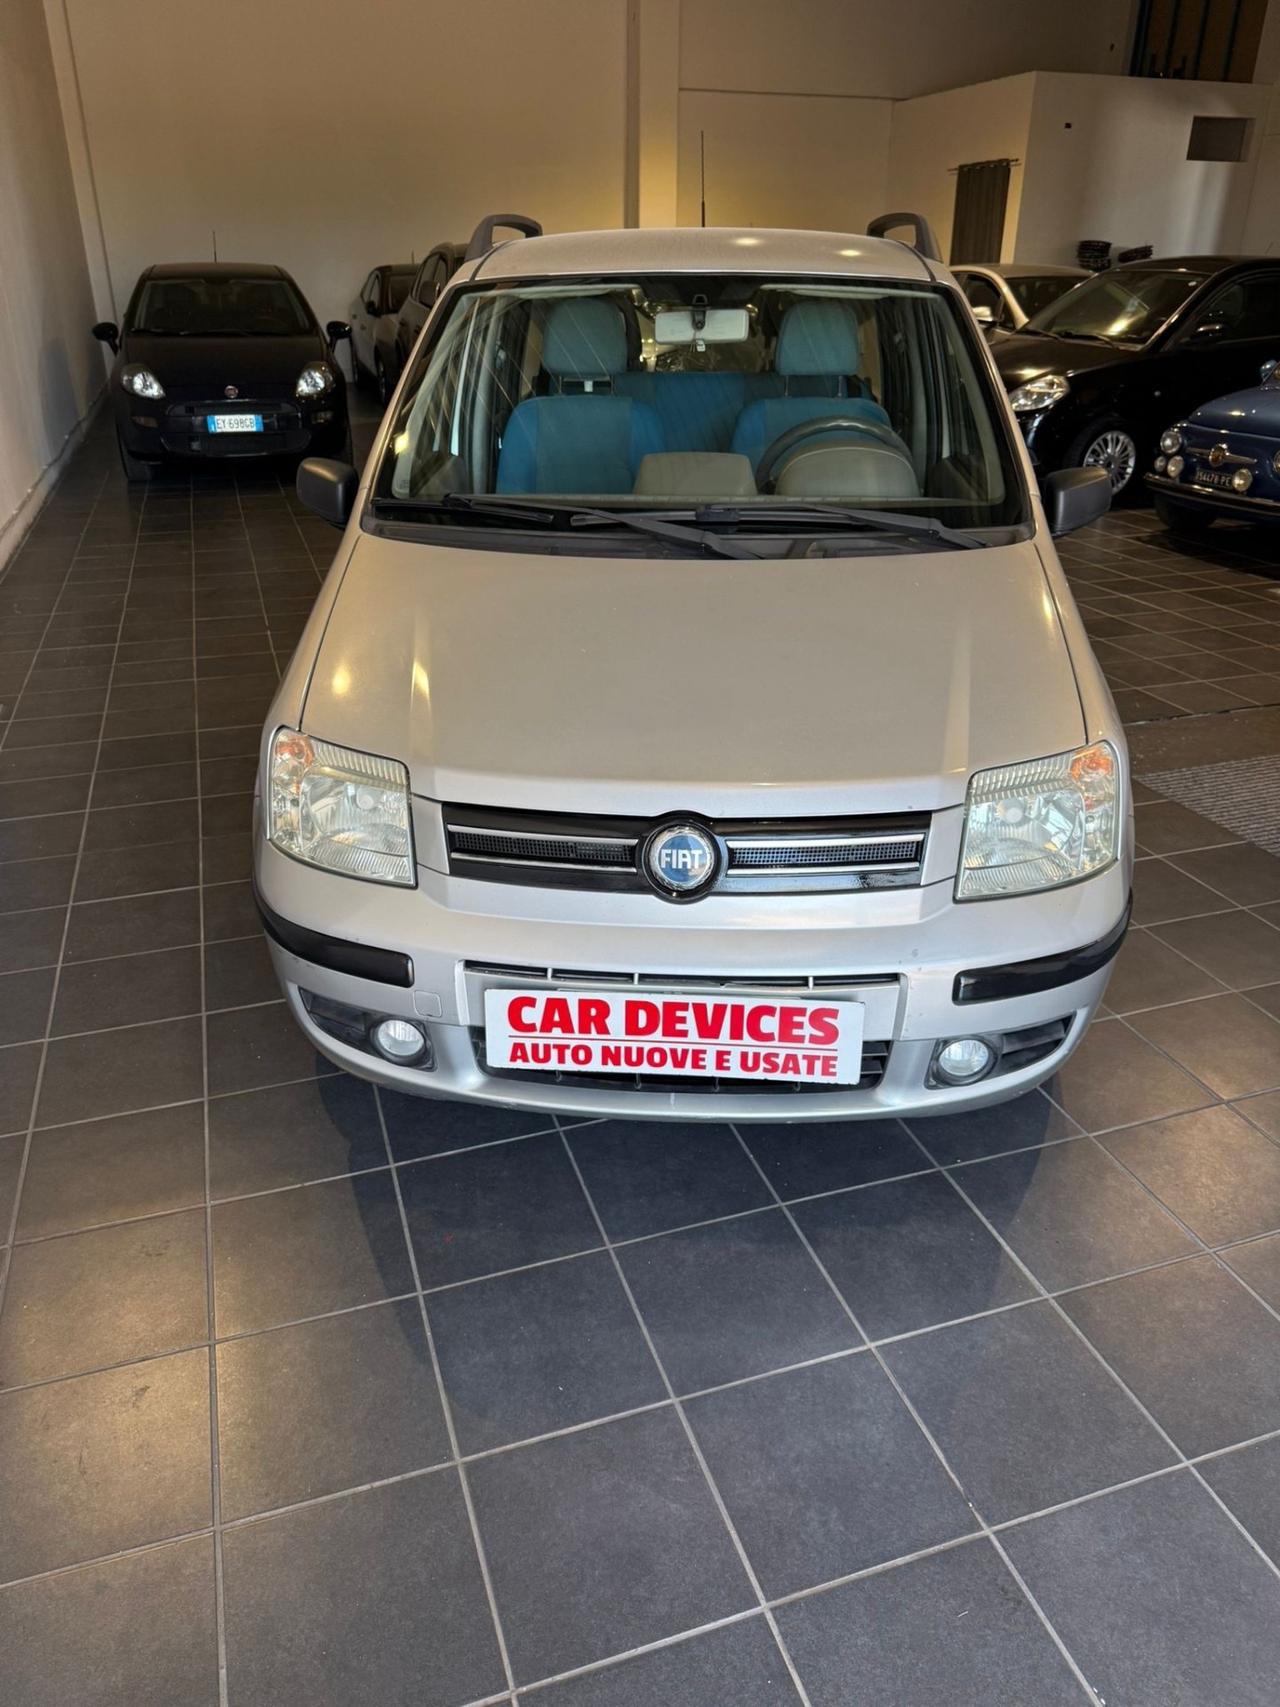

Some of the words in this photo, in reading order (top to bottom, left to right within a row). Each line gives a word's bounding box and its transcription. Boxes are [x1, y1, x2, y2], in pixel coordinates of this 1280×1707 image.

[660, 848, 703, 869] FIAT
[507, 996, 611, 1036] CAR
[624, 999, 840, 1046] DEVICES
[509, 1042, 593, 1066] AUTO
[600, 1045, 706, 1071] NUOVE
[714, 1050, 731, 1072] E
[739, 1051, 837, 1077] USATE
